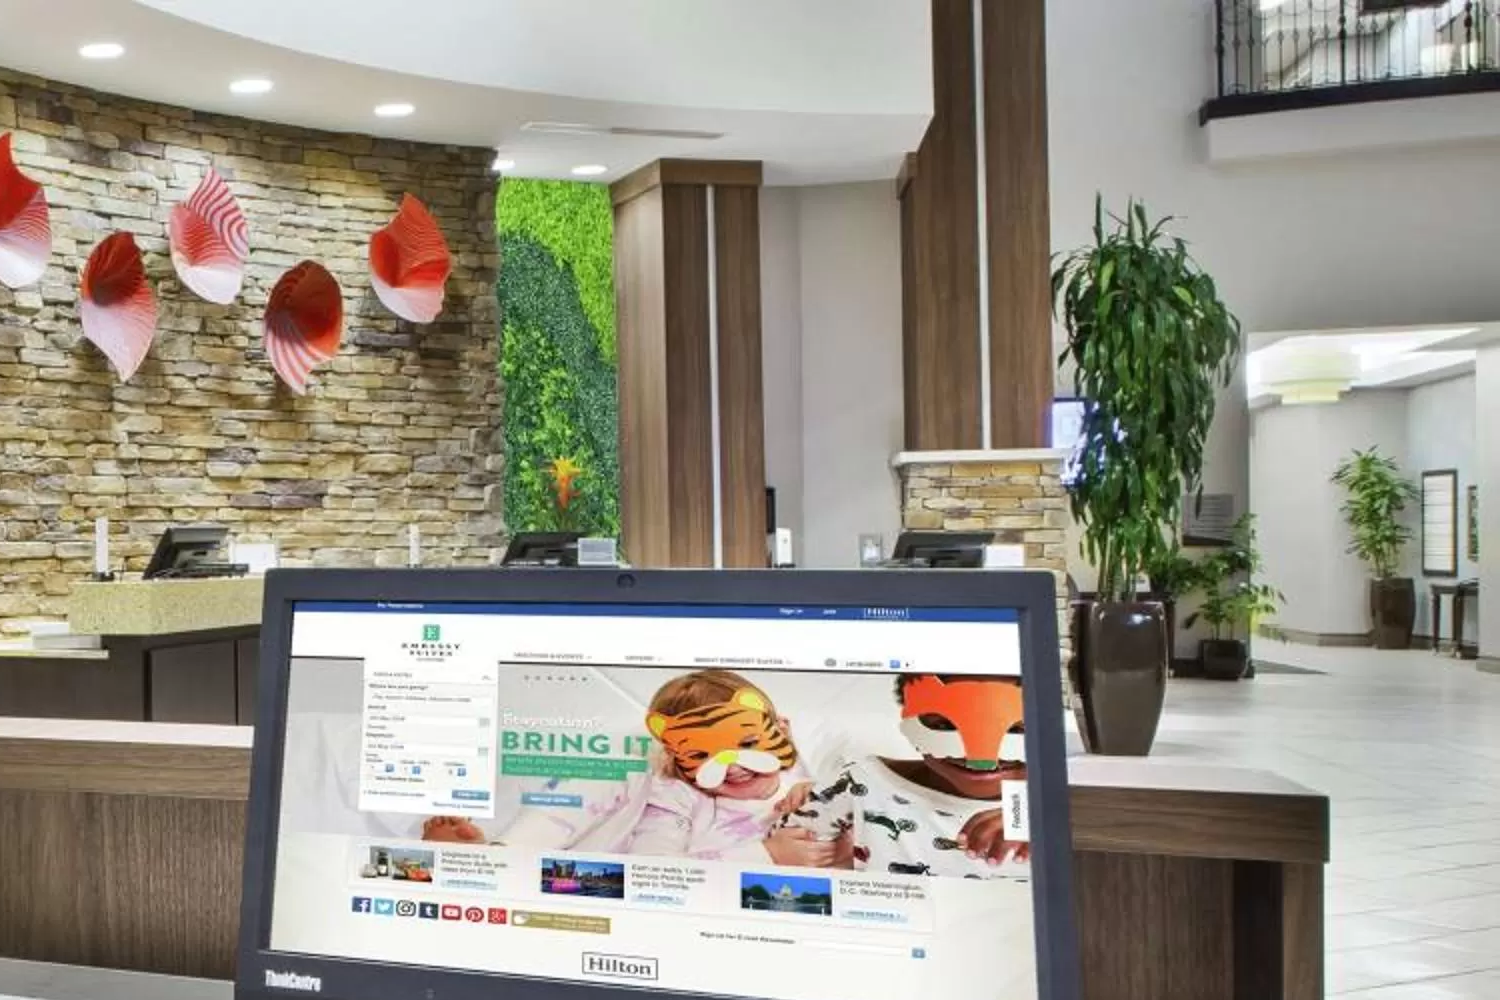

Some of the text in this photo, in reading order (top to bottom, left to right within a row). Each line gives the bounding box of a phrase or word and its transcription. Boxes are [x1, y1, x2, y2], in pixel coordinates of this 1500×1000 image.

[867, 607, 905, 617] Hilton
[400, 642, 461, 650] EMBASSY
[501, 731, 653, 756] BRING IT
[588, 956, 651, 976] Hilton
